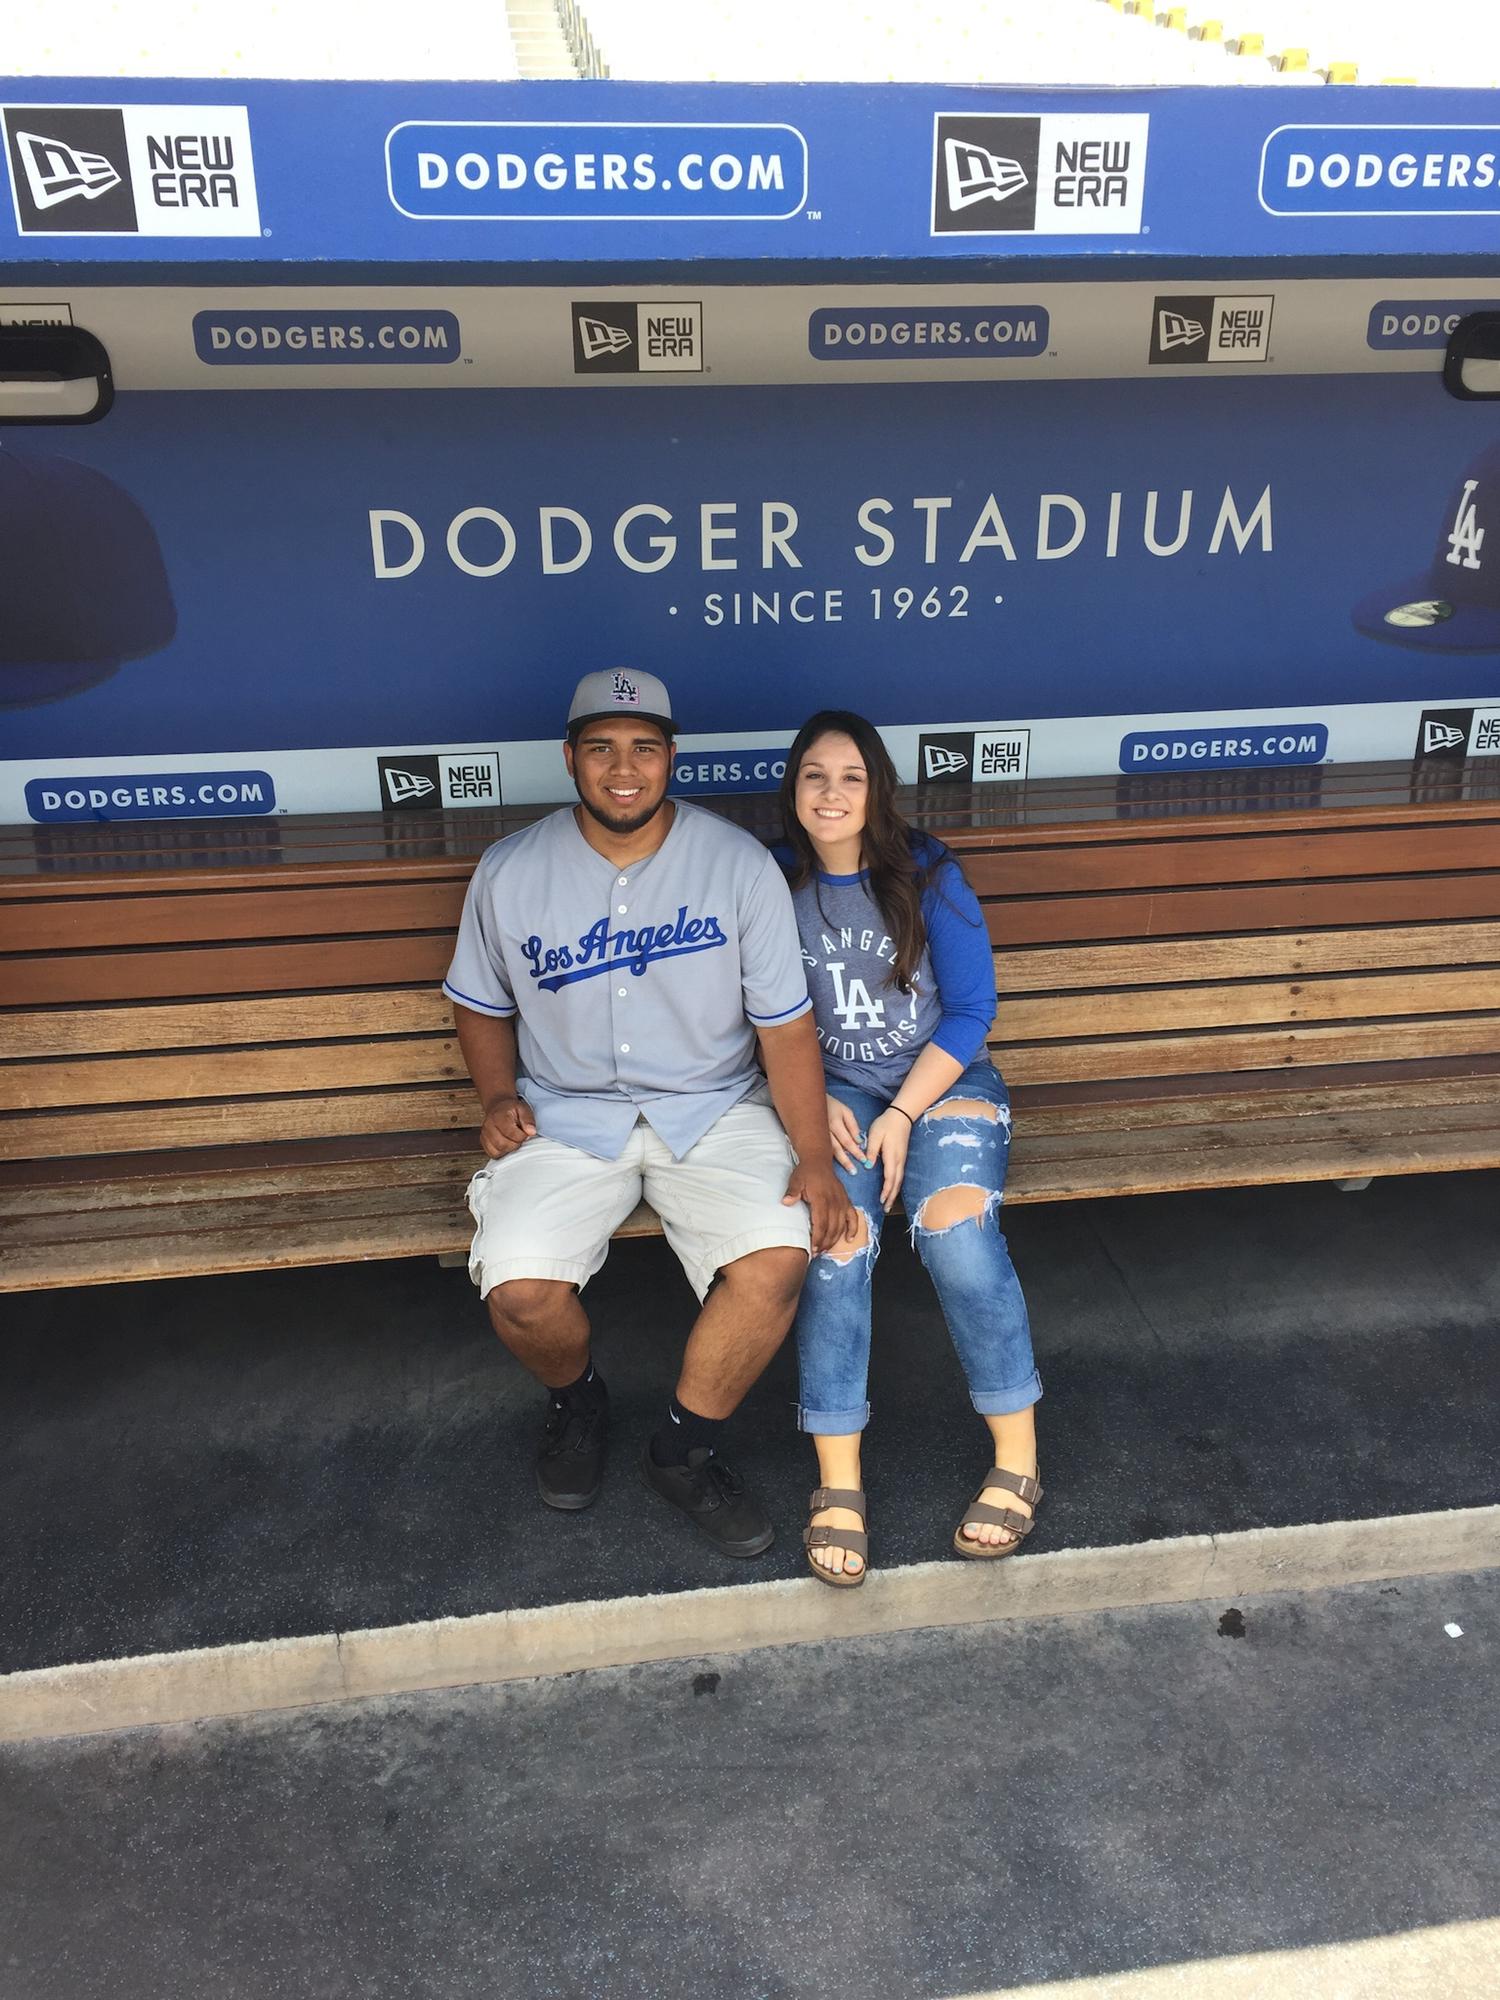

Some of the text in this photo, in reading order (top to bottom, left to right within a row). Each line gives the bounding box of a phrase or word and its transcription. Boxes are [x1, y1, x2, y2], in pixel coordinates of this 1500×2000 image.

[147, 136, 233, 170] NEW
[1056, 142, 1130, 173] NEW
[418, 153, 784, 191] DODGERS.COM
[1287, 154, 1500, 188] DODGERS
[152, 173, 238, 207] ERA
[1054, 175, 1127, 207] ERA
[648, 318, 692, 337] NEW
[824, 321, 1037, 345] DODGERS.COM
[1221, 310, 1264, 329] NEW
[211, 326, 448, 350] DODGERS.COM
[648, 338, 693, 357] ERA
[1219, 330, 1261, 348] ERA
[368, 484, 1275, 579] DODGER STADIUM
[1446, 479, 1485, 570] LA
[704, 586, 969, 626] SINCE 1962
[612, 673, 639, 704] LA
[1479, 719, 1500, 734] NE
[982, 742, 1021, 758] NEW
[1132, 735, 1317, 762] DODGERS.COM
[1476, 734, 1500, 750] ER
[449, 766, 491, 782] NEW
[674, 761, 787, 783] GERS.CO
[982, 758, 1020, 774] ERA
[42, 783, 264, 811] DODGERS.COM
[450, 782, 493, 799] ERA
[520, 905, 722, 979] Los Angeles
[826, 962, 886, 1030] LA
